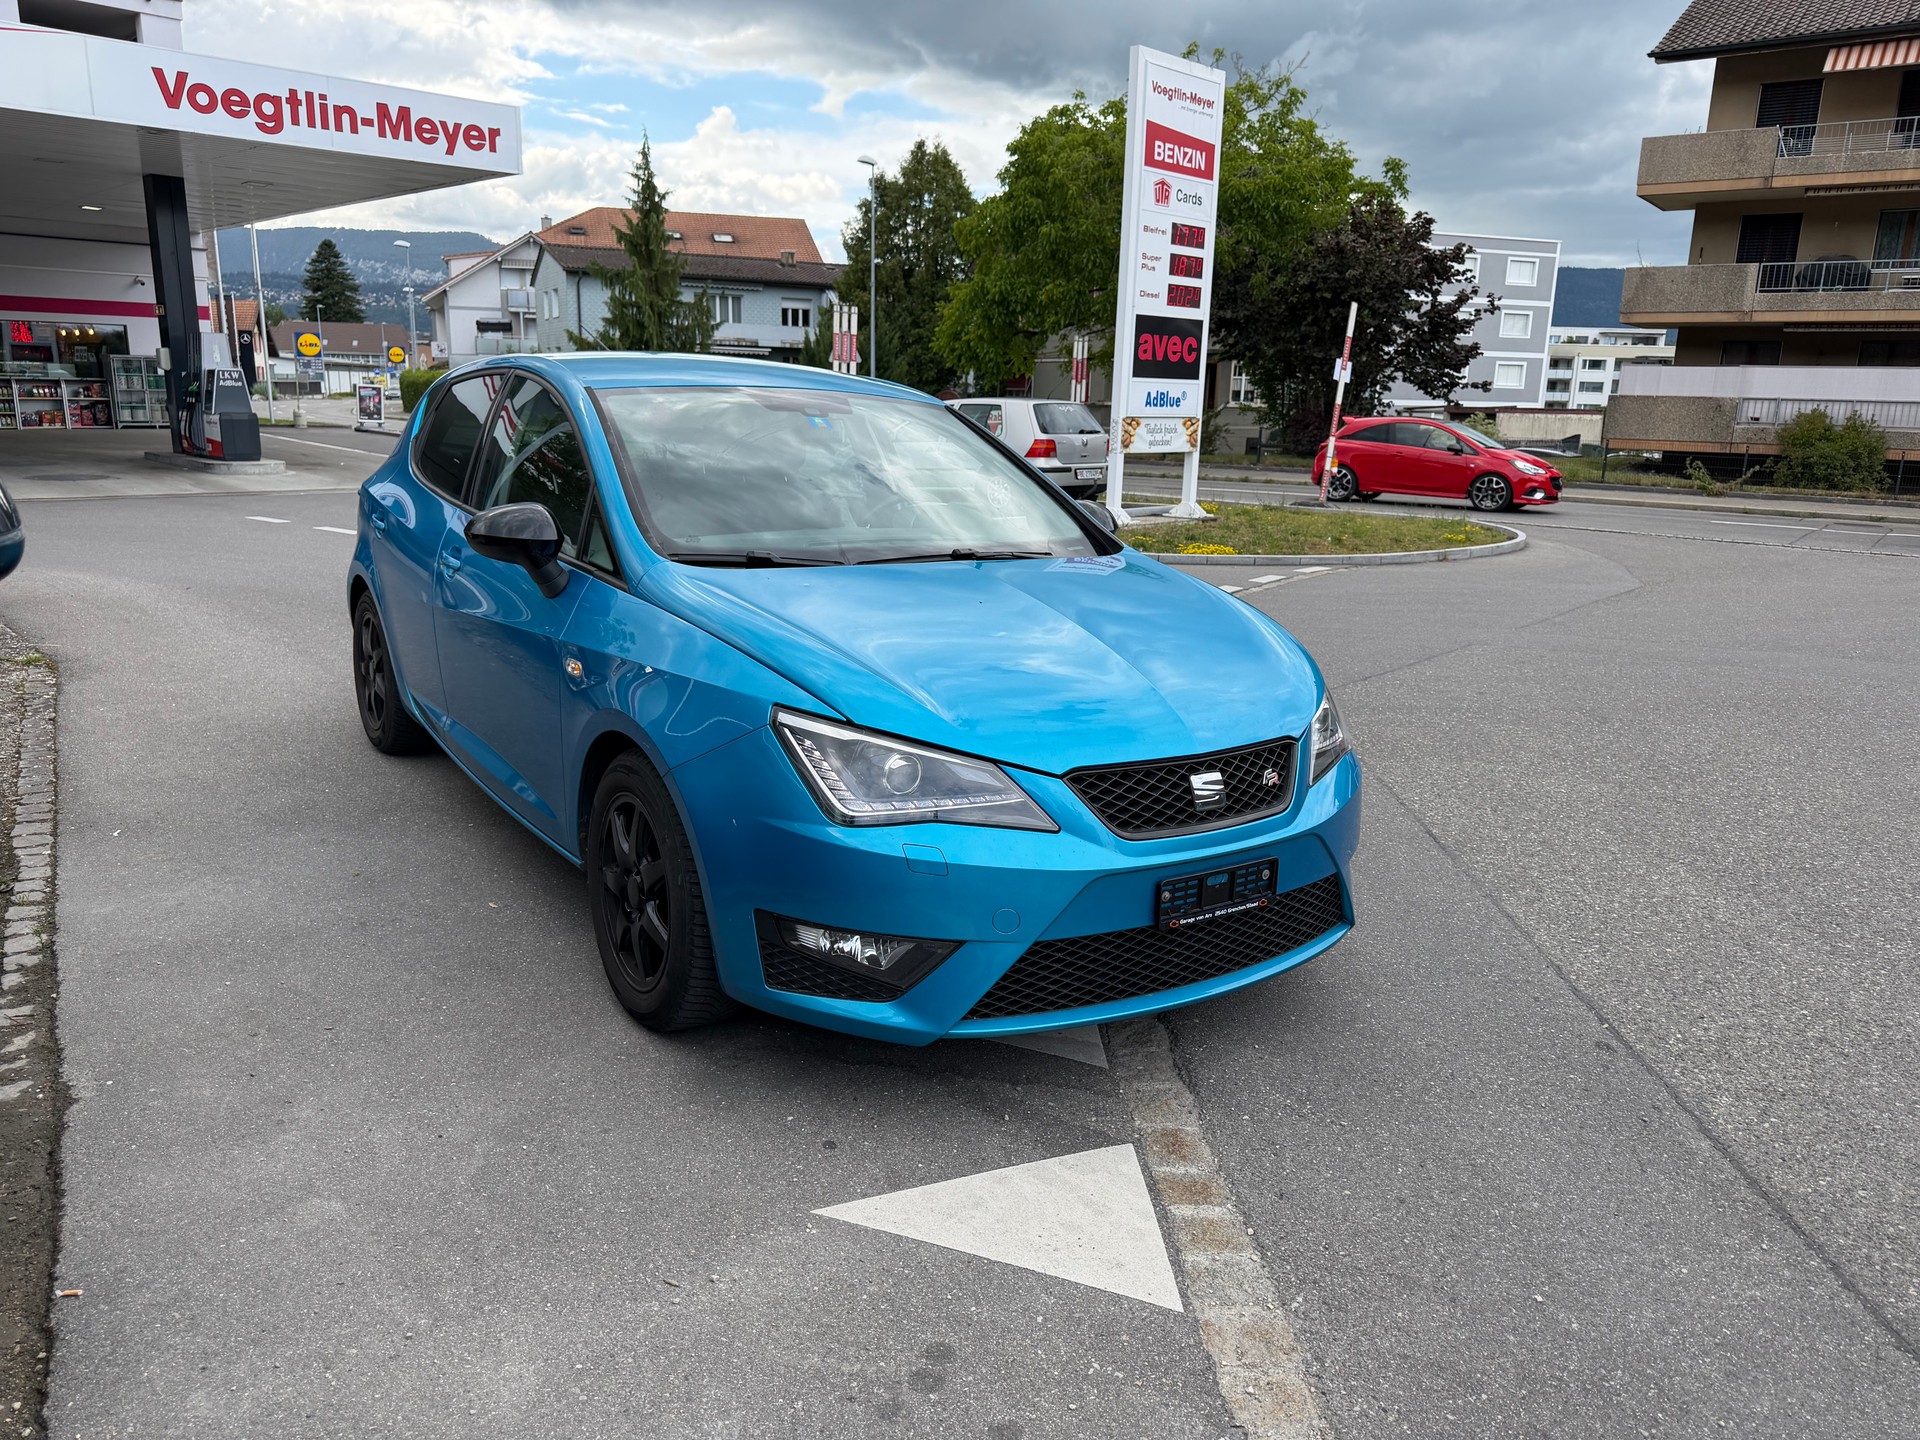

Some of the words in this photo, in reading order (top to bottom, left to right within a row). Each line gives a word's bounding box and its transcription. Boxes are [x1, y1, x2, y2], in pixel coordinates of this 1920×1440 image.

[1152, 80, 1215, 110] Voegtlin-Meyer
[151, 66, 502, 156] Voegtlin-Meyer
[1154, 140, 1206, 171] BENZIN
[1176, 189, 1203, 206] Cards
[1143, 225, 1168, 236] Bleifrei
[1142, 252, 1163, 263] Super
[1141, 263, 1156, 272] Plus
[1139, 290, 1160, 299] Diesel
[1137, 333, 1198, 364] avec
[220, 371, 240, 379] LKW
[219, 379, 243, 387] AdBlue
[1180, 917, 1195, 925] Garage
[1214, 908, 1228, 917] 2540
